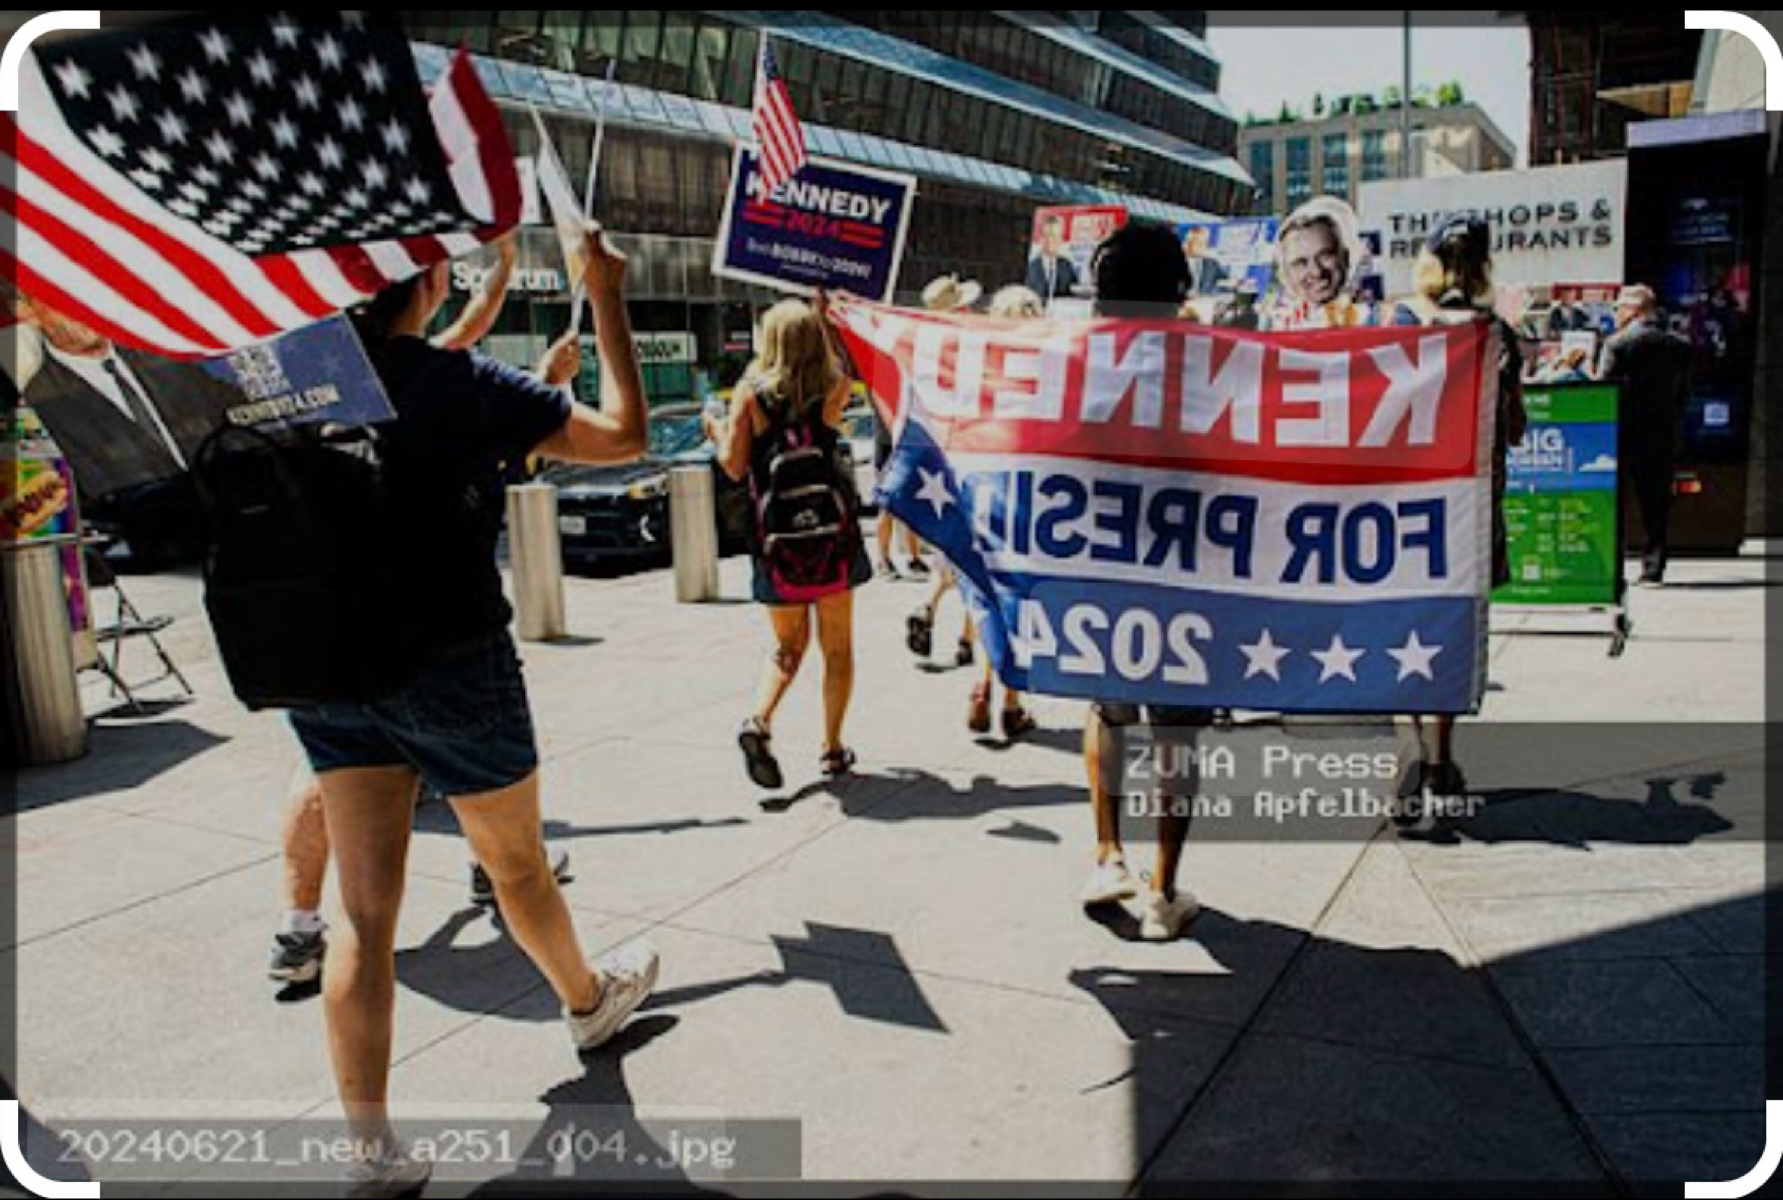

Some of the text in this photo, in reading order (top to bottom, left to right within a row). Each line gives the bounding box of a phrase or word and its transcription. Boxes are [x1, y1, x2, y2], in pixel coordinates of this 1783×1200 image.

[786, 208, 842, 236] 2024
[1387, 212, 1441, 234] TH
[1591, 198, 1611, 221] &
[1389, 225, 1612, 258] REURANTS
